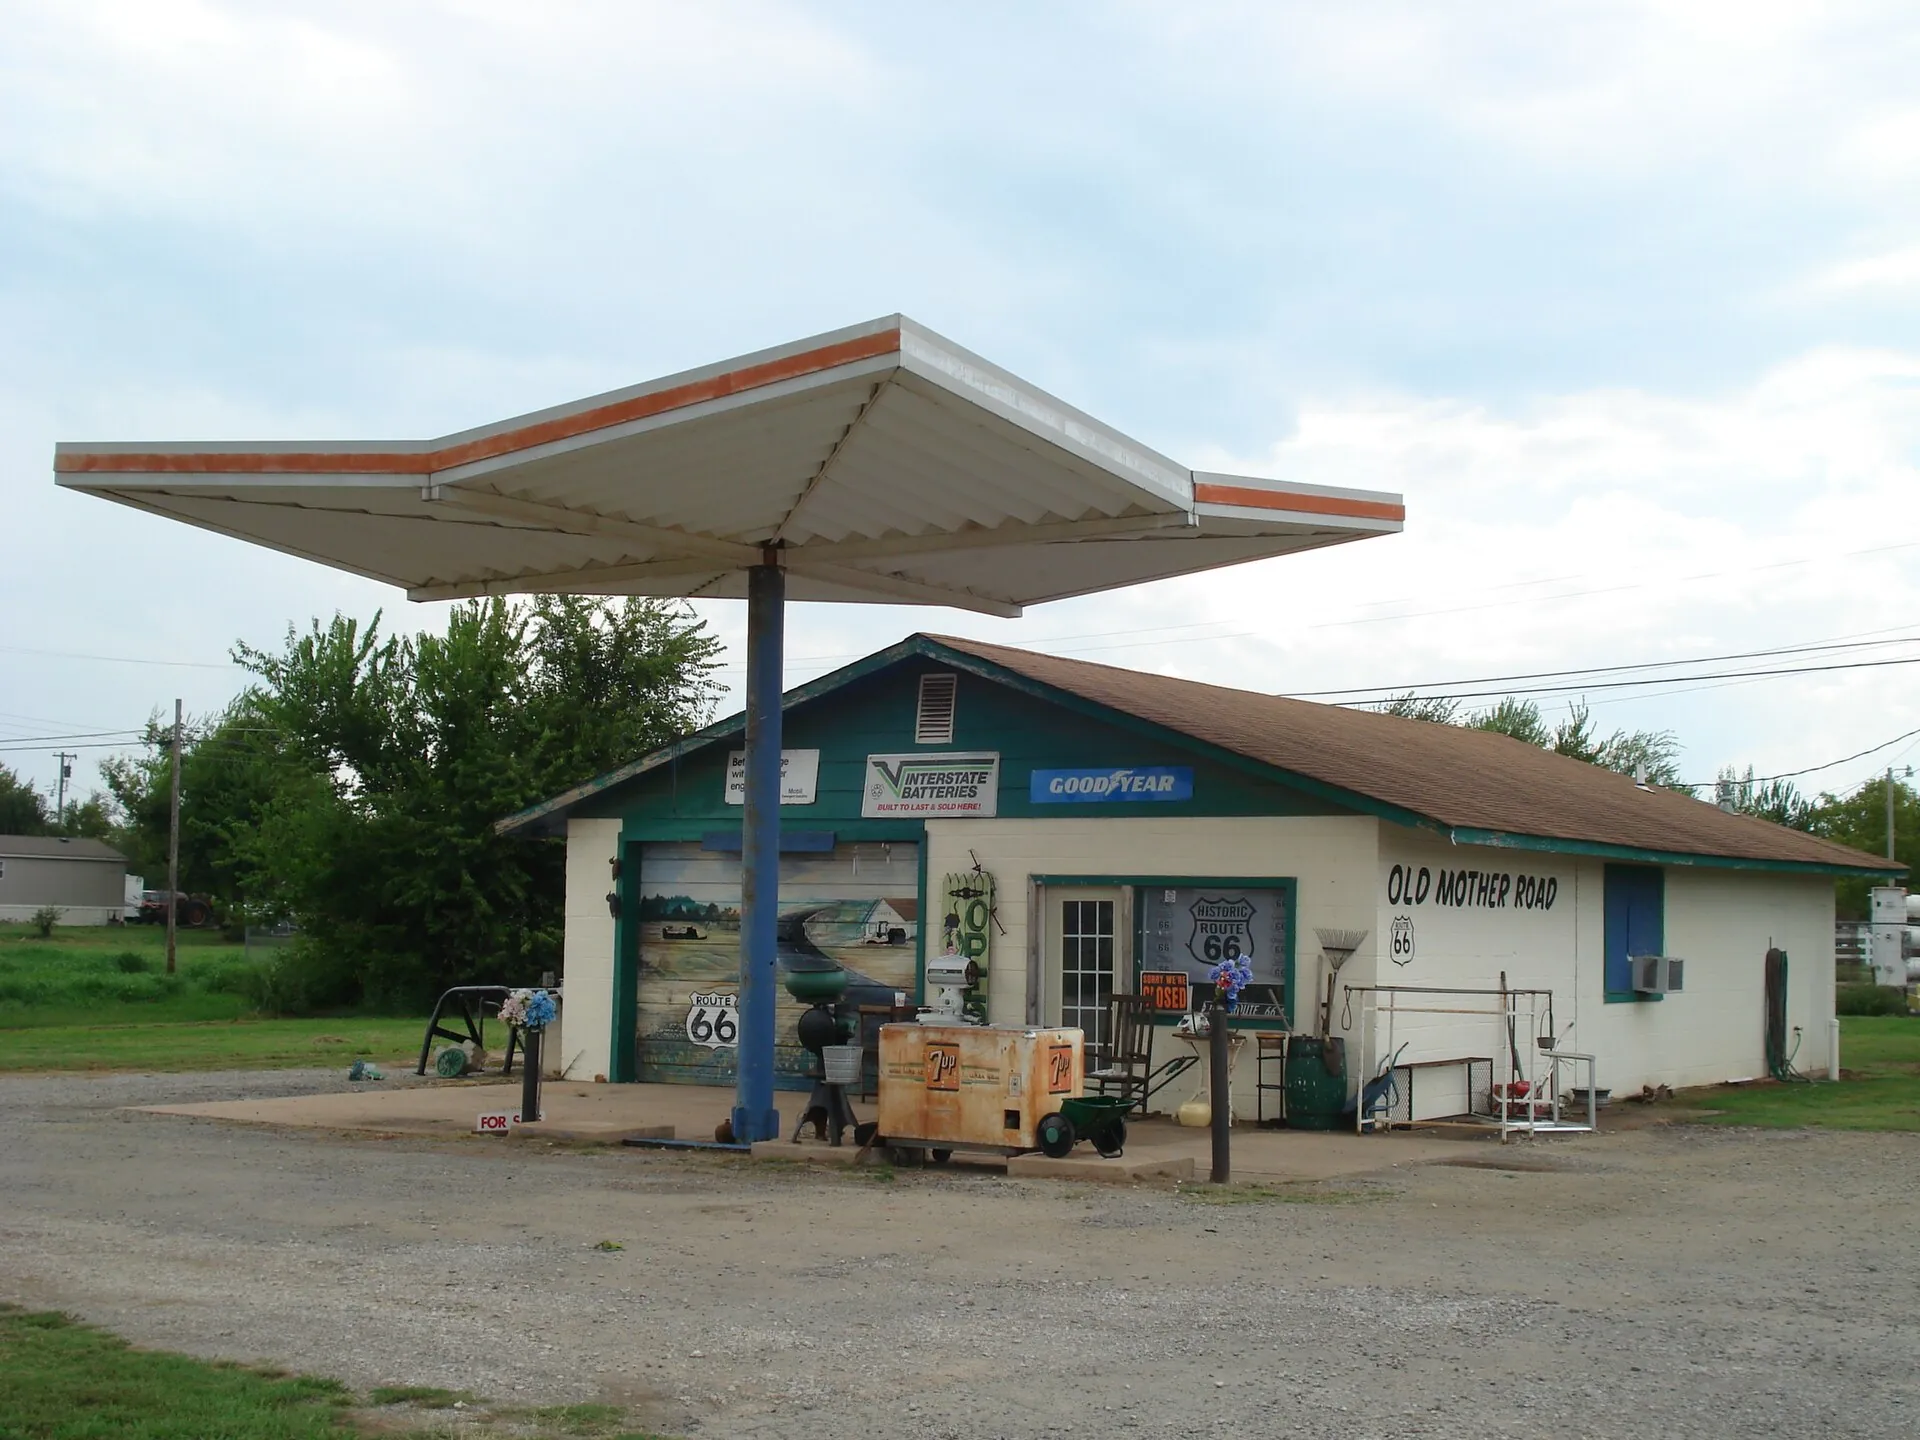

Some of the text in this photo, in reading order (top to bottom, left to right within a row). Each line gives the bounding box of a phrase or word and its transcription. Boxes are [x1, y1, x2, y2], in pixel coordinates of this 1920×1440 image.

[905, 772, 988, 786] INTERSTATE
[1050, 773, 1175, 795] GOODYEAR
[901, 786, 978, 799] BATTERIES
[937, 803, 957, 811] SOLD
[1388, 864, 1558, 911] OLD MOTHER ROAD
[1197, 905, 1248, 918] HISTORIC
[1200, 922, 1244, 935] ROUTE
[1203, 935, 1241, 960] 66
[1394, 930, 1411, 955] 66
[1143, 974, 1186, 985] SORRY WE'RE
[697, 996, 731, 1006] ROUTE
[691, 1007, 737, 1043] 66
[481, 1116, 506, 1129] FOR
